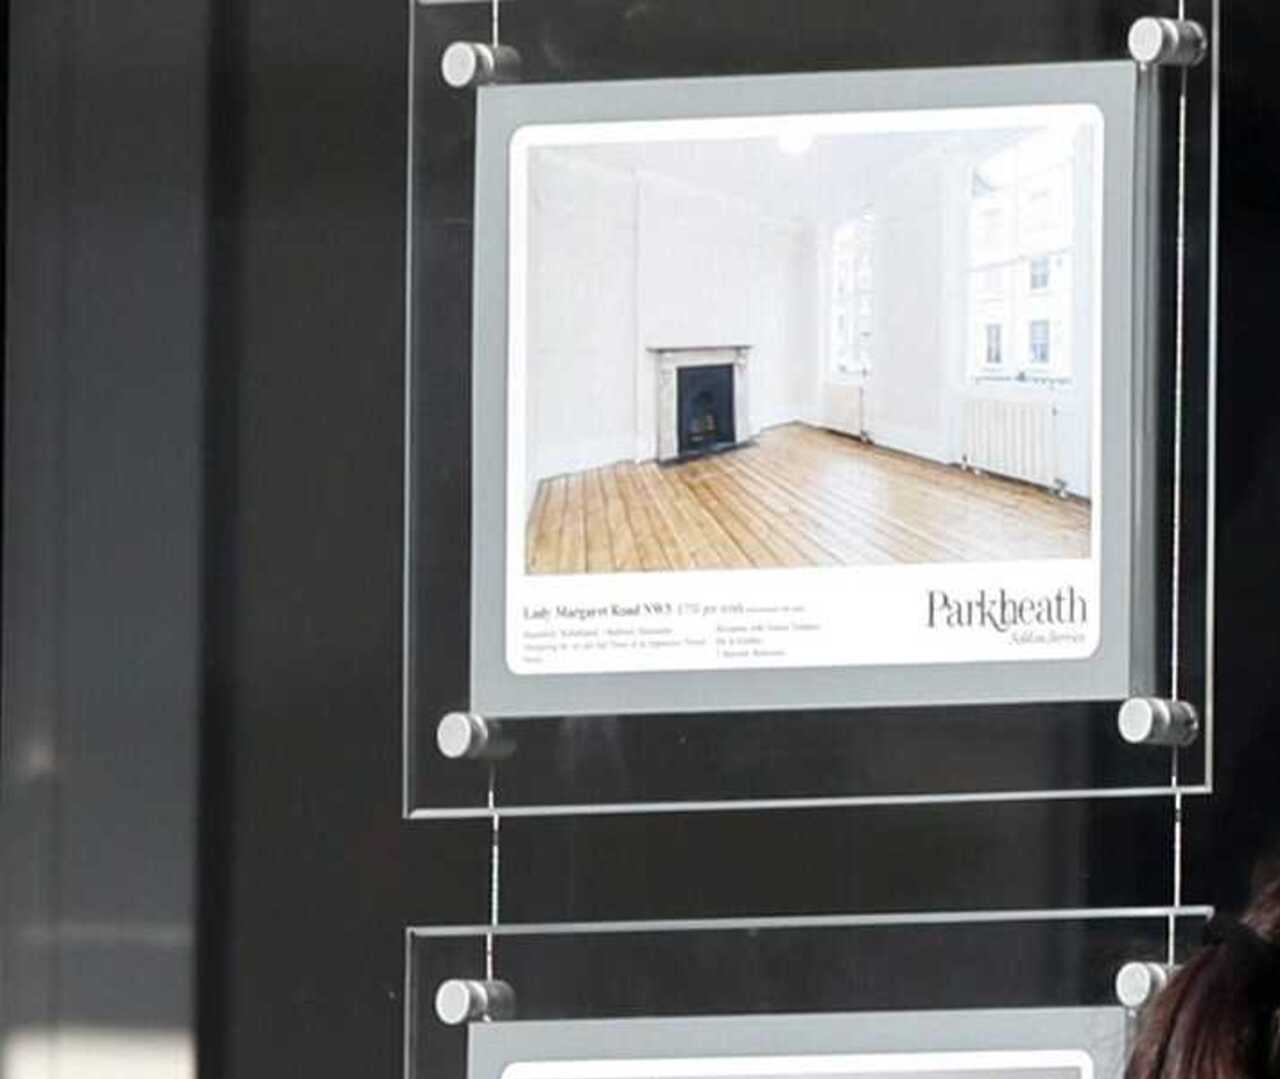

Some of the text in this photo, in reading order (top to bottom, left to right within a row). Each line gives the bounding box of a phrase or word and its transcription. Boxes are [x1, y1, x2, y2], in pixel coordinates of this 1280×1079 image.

[523, 605, 550, 622] Lady
[555, 604, 608, 621] Margaret
[610, 602, 640, 617] Road
[925, 585, 1087, 633] Parkheath
